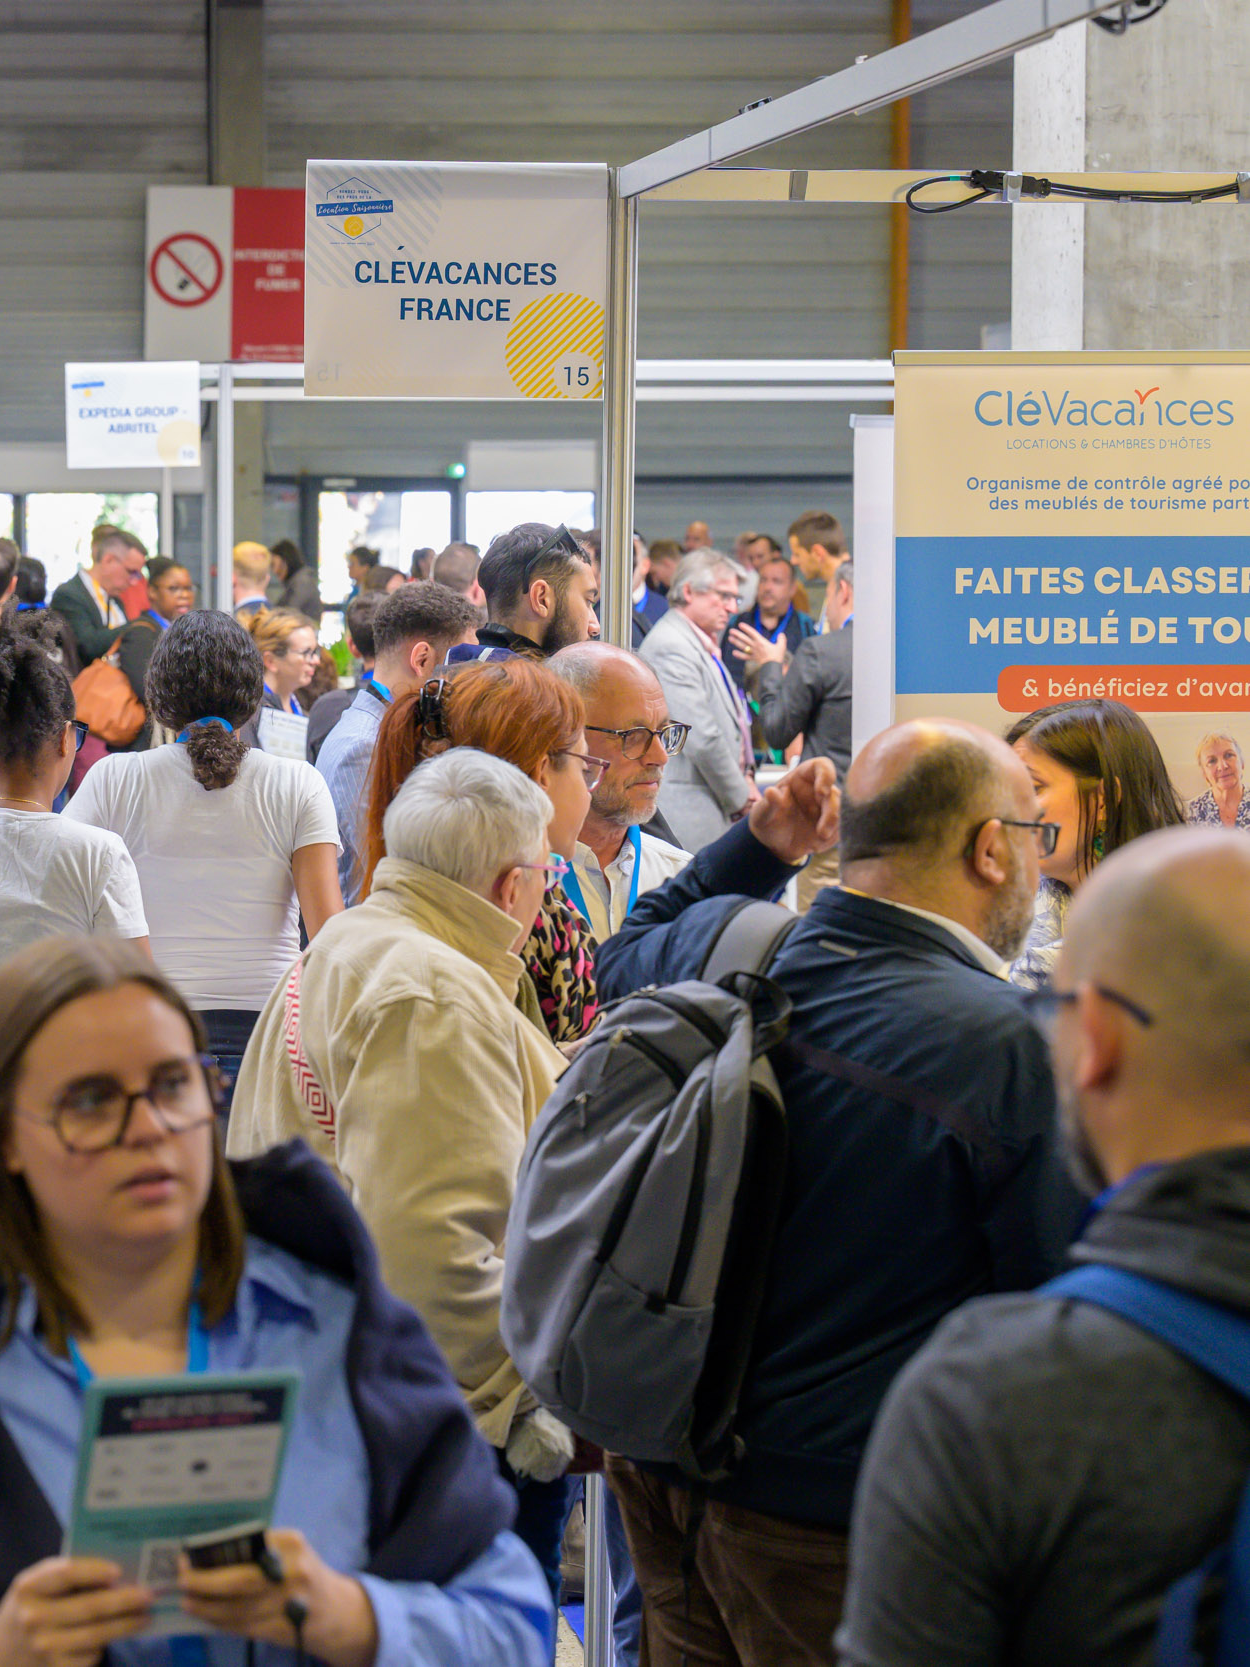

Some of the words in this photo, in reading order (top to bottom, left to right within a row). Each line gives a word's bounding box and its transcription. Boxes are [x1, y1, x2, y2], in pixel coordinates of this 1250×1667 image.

[318, 204, 349, 215] Location
[354, 245, 557, 286] CLÉVACANCES
[399, 297, 511, 322] FRANCE
[563, 366, 590, 386] 15
[78, 407, 131, 419] EXPEDIA
[134, 406, 178, 417] GROUP
[974, 386, 1235, 427] CléVacances
[108, 423, 158, 434] ABRITEL
[1006, 438, 1077, 450] LOCATIONS
[1080, 439, 1088, 450] &
[1092, 438, 1156, 450] CHAMBRES
[1158, 436, 1212, 450] D'HÔTES
[966, 476, 1061, 493] Organisme
[1066, 475, 1088, 491] de
[1094, 475, 1166, 491] contrôle
[1171, 475, 1223, 493] agréé
[989, 496, 1019, 511] des
[1024, 496, 1098, 511] meublés
[1103, 496, 1124, 511] de
[1129, 496, 1207, 511] tourisme
[1212, 497, 1250, 513] part
[955, 566, 1085, 595] FAITES
[968, 609, 1119, 645] MEUBLÉ
[1129, 616, 1178, 644] DE
[1022, 678, 1039, 697] &
[1048, 677, 1168, 697] bénéficiez
